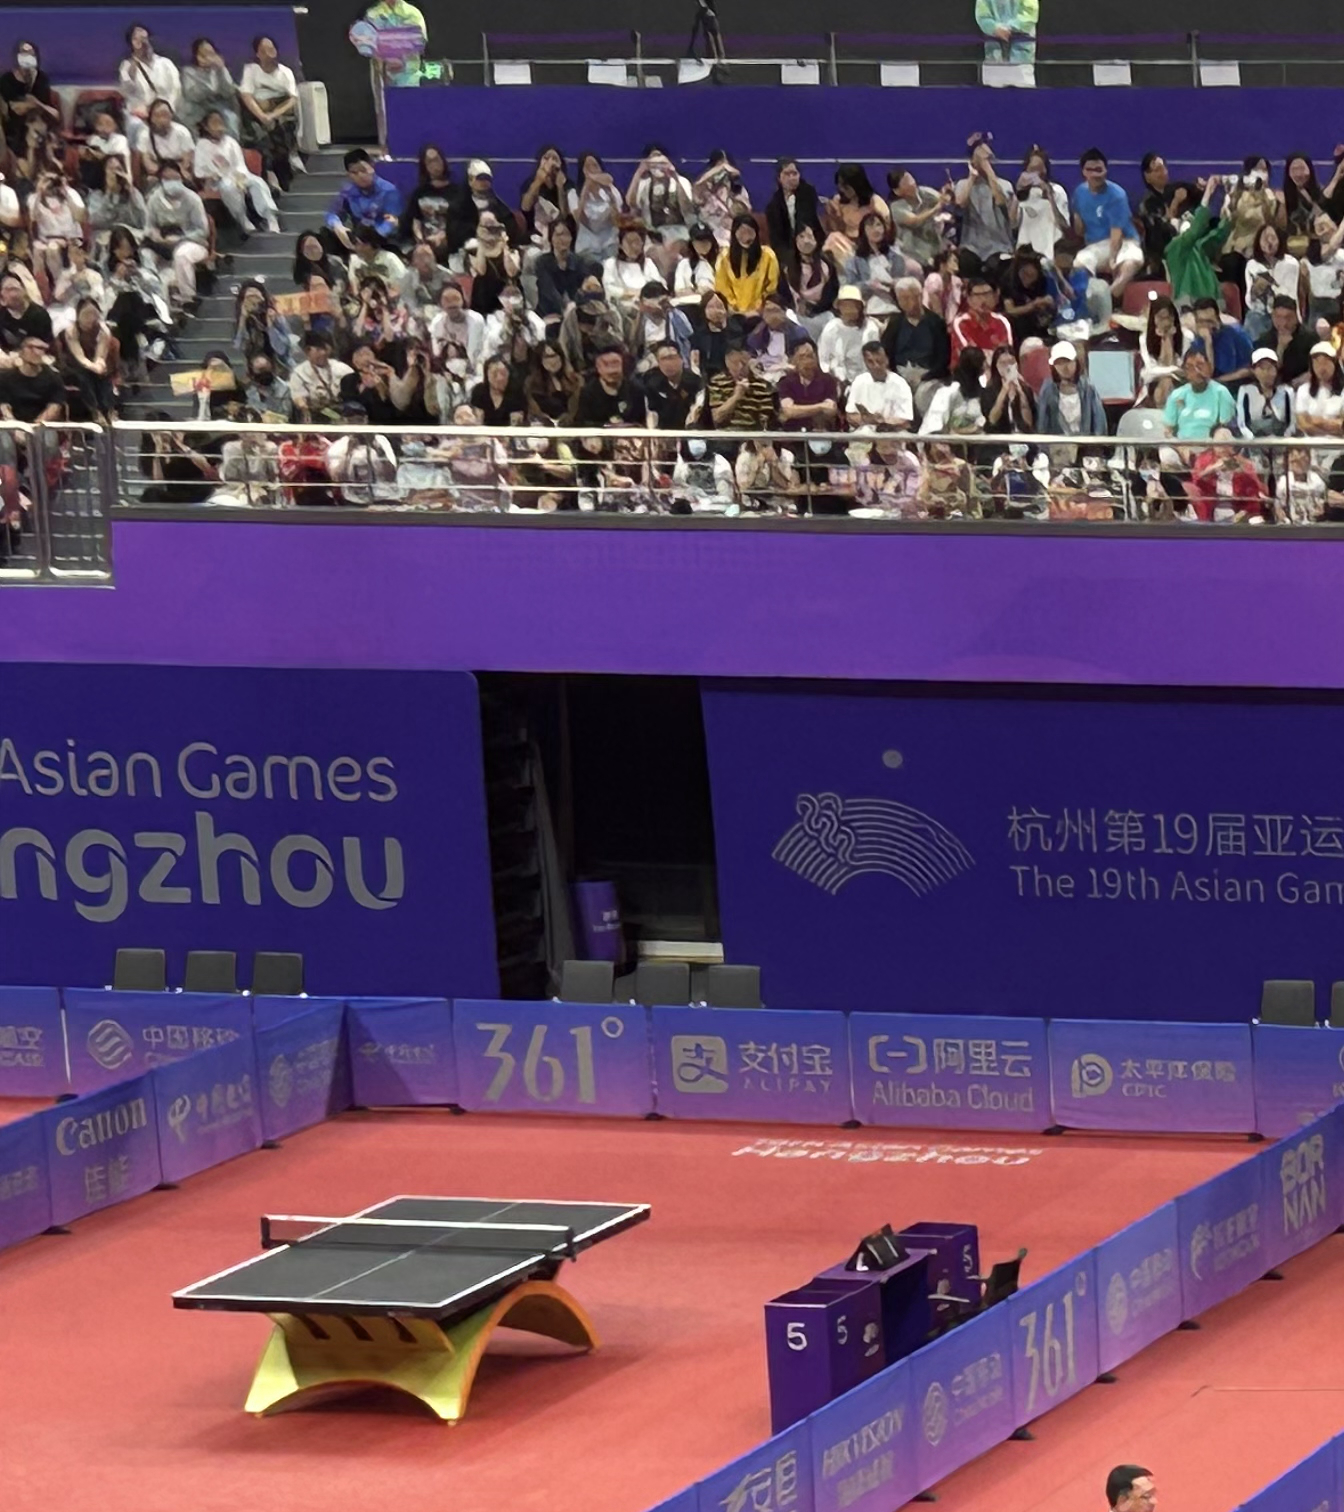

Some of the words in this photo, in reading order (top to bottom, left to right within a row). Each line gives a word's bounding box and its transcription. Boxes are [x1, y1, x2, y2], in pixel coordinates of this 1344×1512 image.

[0, 739, 162, 798] Asian
[177, 742, 399, 802] Games
[1010, 866, 1075, 897] The
[1088, 867, 1161, 902] 19th
[1170, 872, 1265, 903] Asian
[738, 1041, 834, 1077] 支付宝
[933, 1039, 1032, 1079] 阿里云
[872, 1080, 961, 1110] Alibaba
[967, 1084, 1034, 1113] Cloud
[55, 1095, 148, 1156] Canon
[787, 1322, 808, 1351] 5
